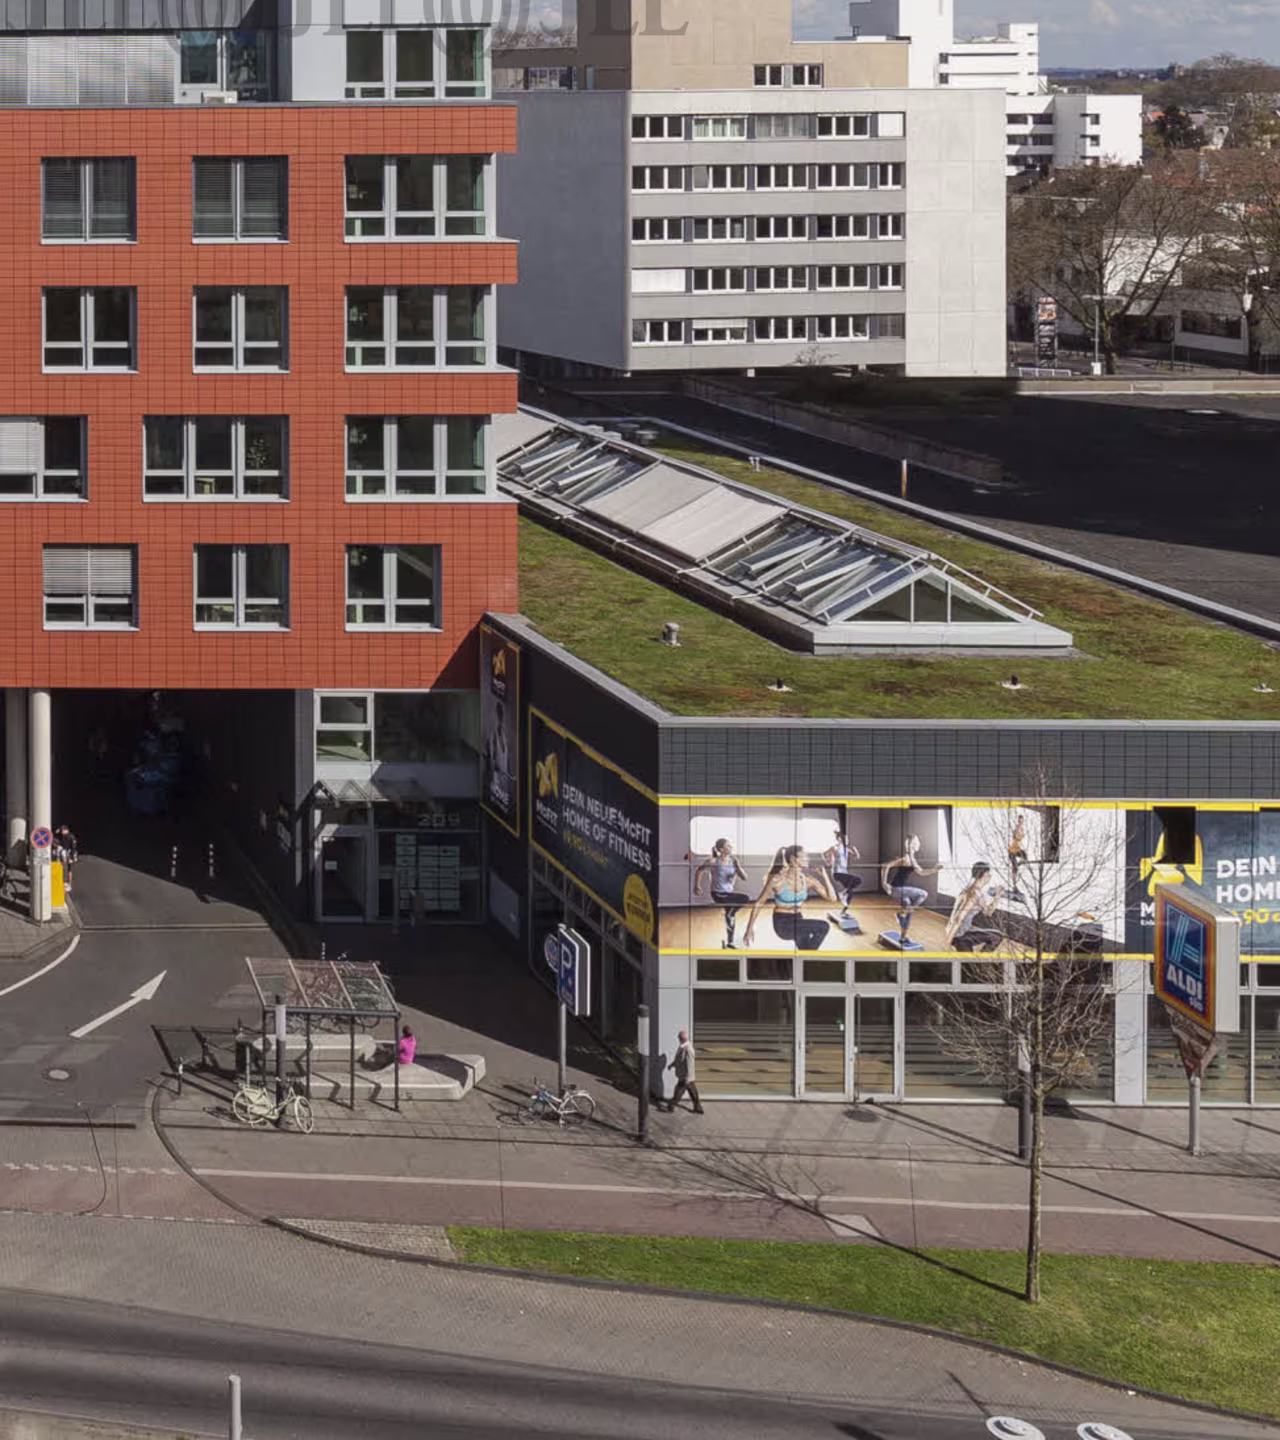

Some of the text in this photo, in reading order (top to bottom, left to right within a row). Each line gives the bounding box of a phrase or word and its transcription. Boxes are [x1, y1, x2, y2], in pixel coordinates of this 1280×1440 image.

[562, 783, 585, 809] DEIN
[622, 815, 652, 846] McFIT
[562, 805, 591, 836] HOME
[592, 823, 607, 844] OF
[608, 832, 652, 871] FITNESS
[1217, 855, 1276, 879] DEIN
[1166, 962, 1203, 1001] ALDI
